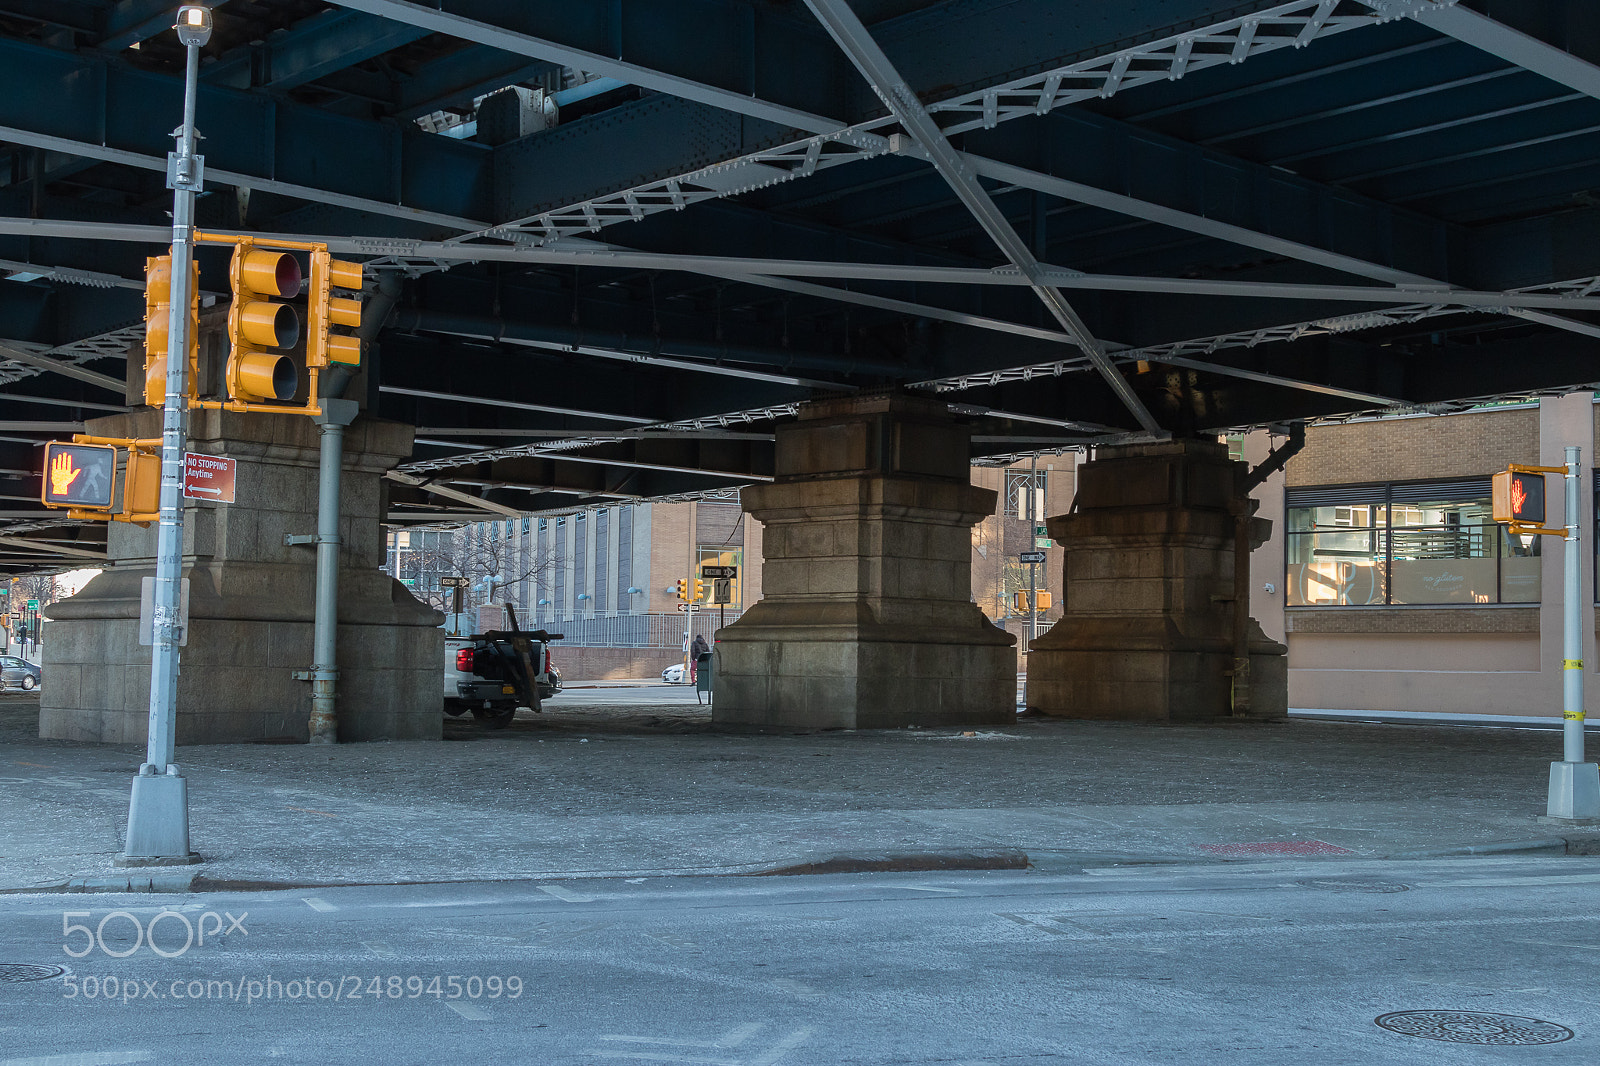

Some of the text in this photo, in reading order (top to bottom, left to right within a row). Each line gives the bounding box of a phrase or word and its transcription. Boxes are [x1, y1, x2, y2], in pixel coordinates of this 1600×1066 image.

[188, 458, 228, 471] NO STOPPING
[188, 468, 213, 479] Anytime
